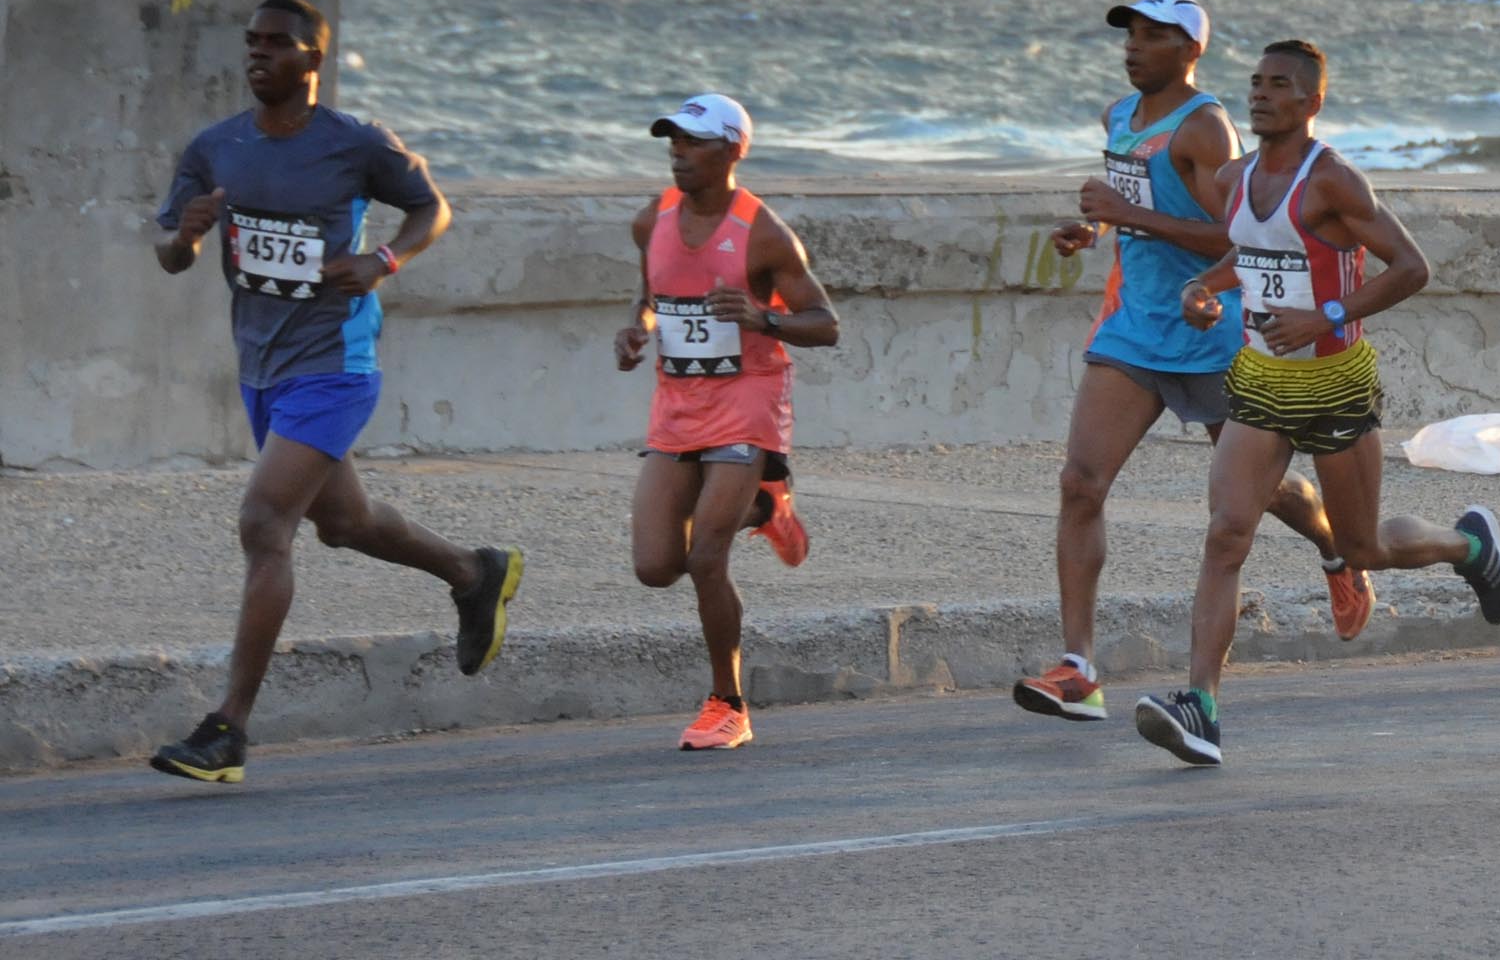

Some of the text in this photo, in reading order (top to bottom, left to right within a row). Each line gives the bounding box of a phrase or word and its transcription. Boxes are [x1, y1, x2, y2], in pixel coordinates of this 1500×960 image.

[246, 233, 307, 266] 4576
[1261, 272, 1285, 299] 28
[683, 319, 709, 344] 25
